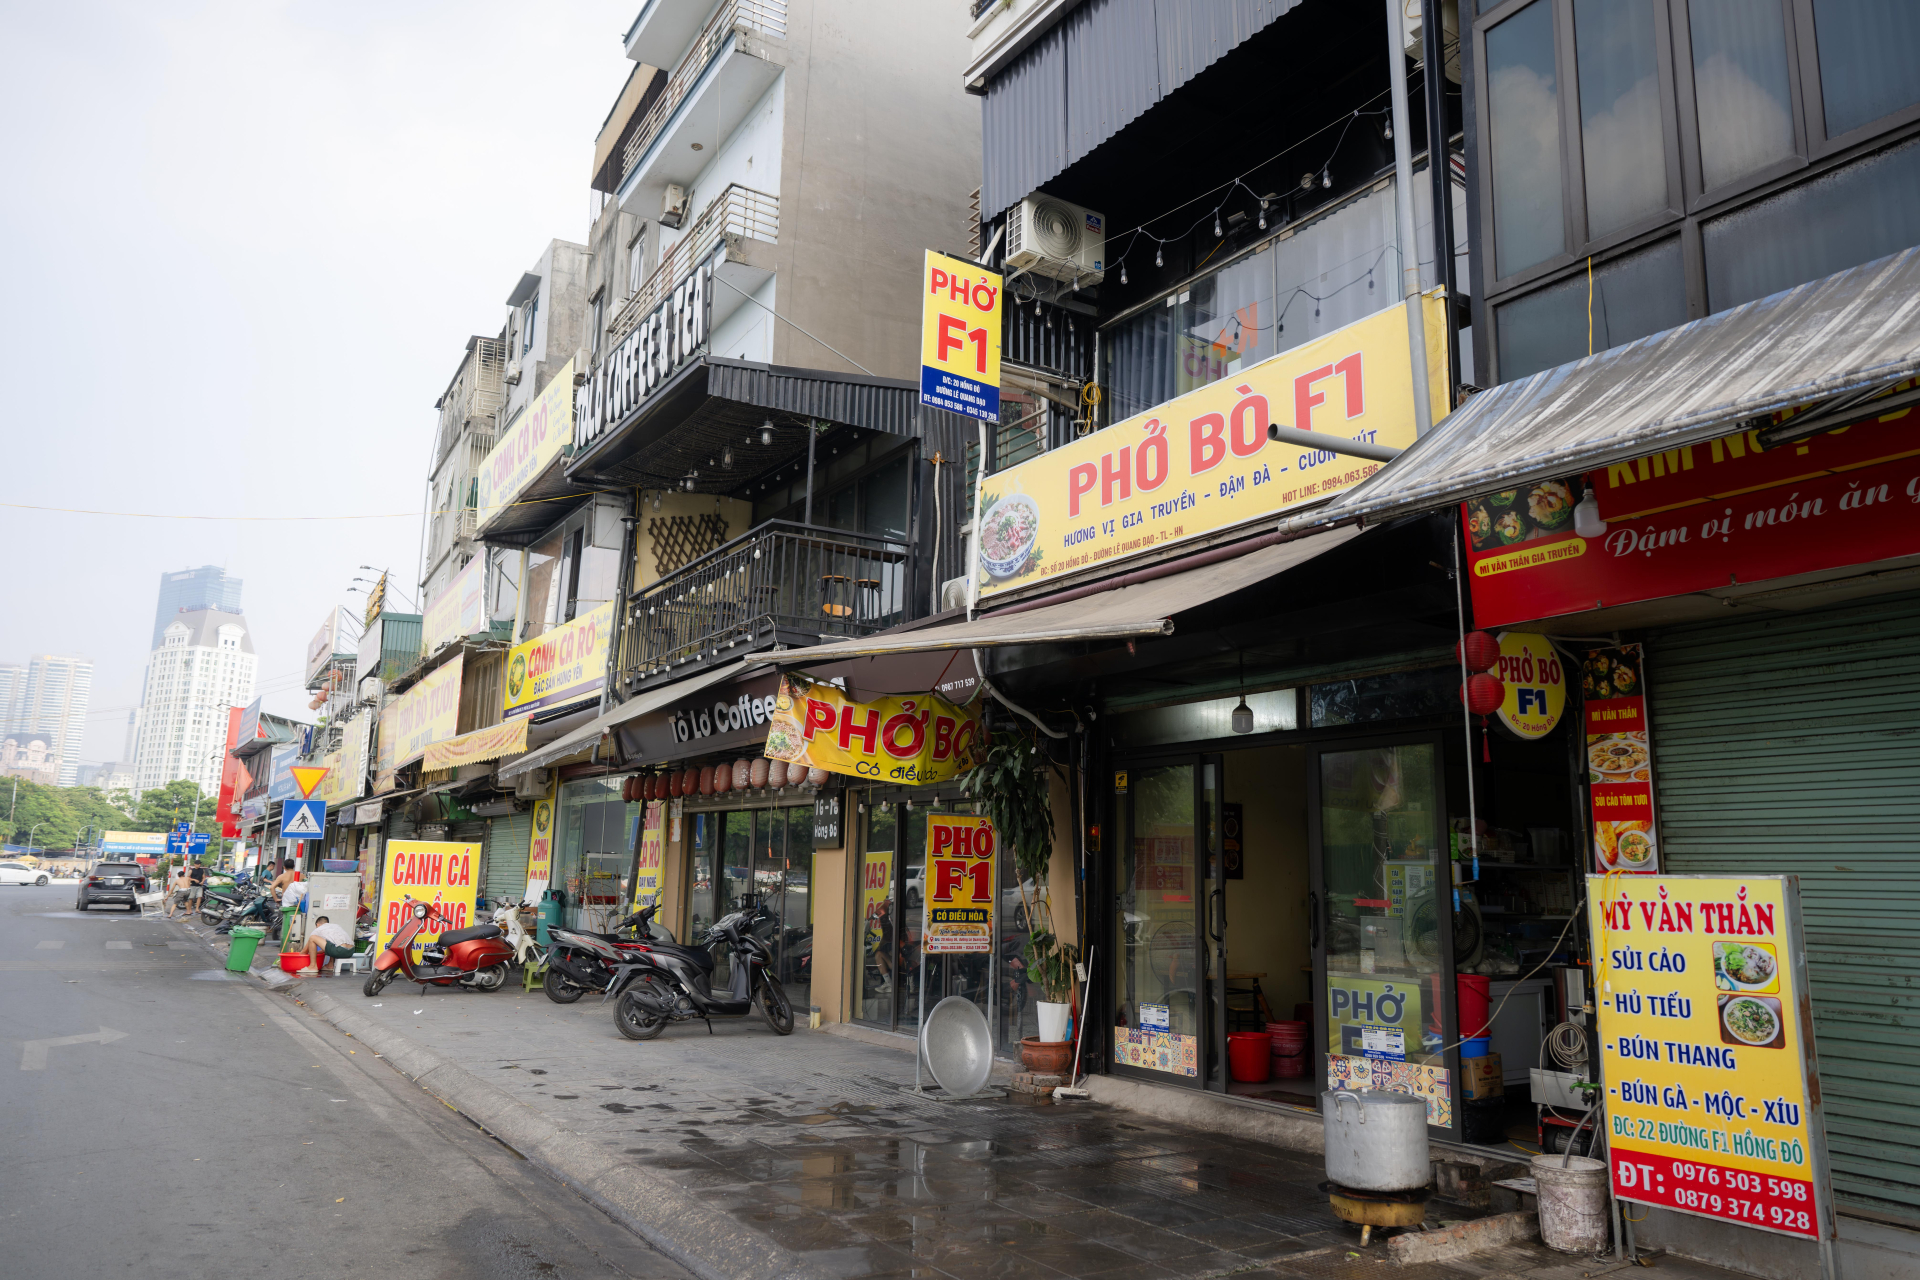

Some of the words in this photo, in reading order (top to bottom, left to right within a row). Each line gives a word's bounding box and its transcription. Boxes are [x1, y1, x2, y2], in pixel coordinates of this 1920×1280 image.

[930, 265, 998, 313] PHỞ
[673, 266, 708, 366] TEA
[937, 312, 988, 375] F1
[960, 392, 976, 404] QUANG
[493, 437, 515, 491] CANH
[517, 412, 529, 465] CÁ
[532, 394, 548, 451] RÔ
[1068, 417, 1170, 519] PHỞ
[1189, 383, 1270, 476] BÒ
[1293, 351, 1365, 432] F1
[1282, 489, 1298, 504] HOT
[1299, 482, 1320, 498] LINE:
[1322, 463, 1379, 491] 0984.063.586
[1063, 525, 1096, 548] HƯƠNG
[1102, 518, 1115, 537] VỊ
[1122, 510, 1143, 529] GIA
[1150, 489, 1196, 520] TRUYỀN
[1219, 475, 1245, 499] ĐẬM
[1253, 463, 1271, 487] ĐÀ
[1603, 525, 1692, 558] Đậm
[1701, 507, 1735, 543] vị
[1744, 491, 1828, 529] món
[1839, 480, 1893, 510] ăn
[1040, 566, 1049, 576] ĐC:
[1051, 559, 1057, 574] SỐ
[1058, 561, 1065, 571] 20
[1081, 551, 1089, 563] ĐÔ
[1093, 544, 1113, 560] ĐƯỜNG
[1113, 543, 1121, 554] LÊ
[1121, 540, 1141, 554] QUANG
[1143, 534, 1155, 548] ĐẠO
[1160, 531, 1168, 541] TL
[1174, 525, 1184, 537] HN
[1479, 563, 1489, 575] MÌ
[1532, 552, 1546, 564] GIA
[1547, 543, 1580, 560] TRUYỀN
[528, 638, 557, 679] CANH
[559, 623, 574, 667] CÁ
[576, 613, 596, 661] RÔ
[1498, 644, 1534, 684] PHỞ
[1536, 650, 1561, 686] BÒ
[533, 678, 544, 698] ĐẶC
[545, 671, 556, 690] SẢN
[556, 669, 572, 687] HƯNG
[573, 661, 583, 681] YÊN
[941, 681, 954, 692] 0987
[954, 679, 964, 690] 717
[668, 710, 689, 744] Tô
[689, 707, 711, 740] Lơ
[714, 693, 777, 734] Coffee
[1517, 687, 1548, 716] F1
[1591, 708, 1601, 721] MÌ
[801, 697, 930, 760] PHỞ
[1522, 722, 1531, 731] 20
[856, 760, 881, 776] Có
[890, 764, 923, 782] điều
[1595, 792, 1606, 807] SỦI
[1606, 792, 1619, 807] CẢO
[1619, 793, 1633, 806] TÔM
[1633, 793, 1648, 806] TƯƠI
[814, 819, 828, 839] Hồng
[931, 819, 994, 858] PHỞ
[392, 851, 444, 887] CANH
[446, 847, 470, 888] CÁ
[533, 838, 549, 862] CANH
[648, 833, 660, 869] RÔ
[933, 859, 992, 902] F1
[418, 890, 467, 935] ỒNG
[936, 909, 947, 921] CÓ
[949, 909, 966, 921] ĐIỀU
[968, 910, 984, 921] HÒA
[1599, 892, 1633, 931] MỲ
[1612, 945, 1642, 972] SỦI
[1648, 945, 1686, 974] CẢO
[1330, 983, 1407, 1025] PHỞ
[1615, 988, 1642, 1014] HỦ
[1646, 991, 1692, 1019] TIẾU
[1619, 1034, 1660, 1061] BÚN
[1664, 1043, 1736, 1070] THANG
[1621, 1077, 1660, 1106] BÚN
[1664, 1083, 1689, 1110] GÀ
[1704, 1089, 1747, 1122] MỘC
[1763, 1096, 1800, 1126] XÍU
[1613, 1115, 1636, 1138] ĐC:
[1638, 1119, 1656, 1141] 22
[1659, 1121, 1709, 1150] ĐƯỜNG
[1712, 1131, 1730, 1153] F1
[1733, 1128, 1777, 1163] HỒNG
[1780, 1140, 1804, 1166] ĐÔ
[1618, 1161, 1665, 1194] ĐT:
[1672, 1161, 1721, 1186] 0976
[1725, 1171, 1762, 1194] 503
[1768, 1177, 1808, 1202] 598
[1674, 1188, 1723, 1213] 0879
[1728, 1198, 1766, 1222] 374
[1770, 1206, 1811, 1230] 928
